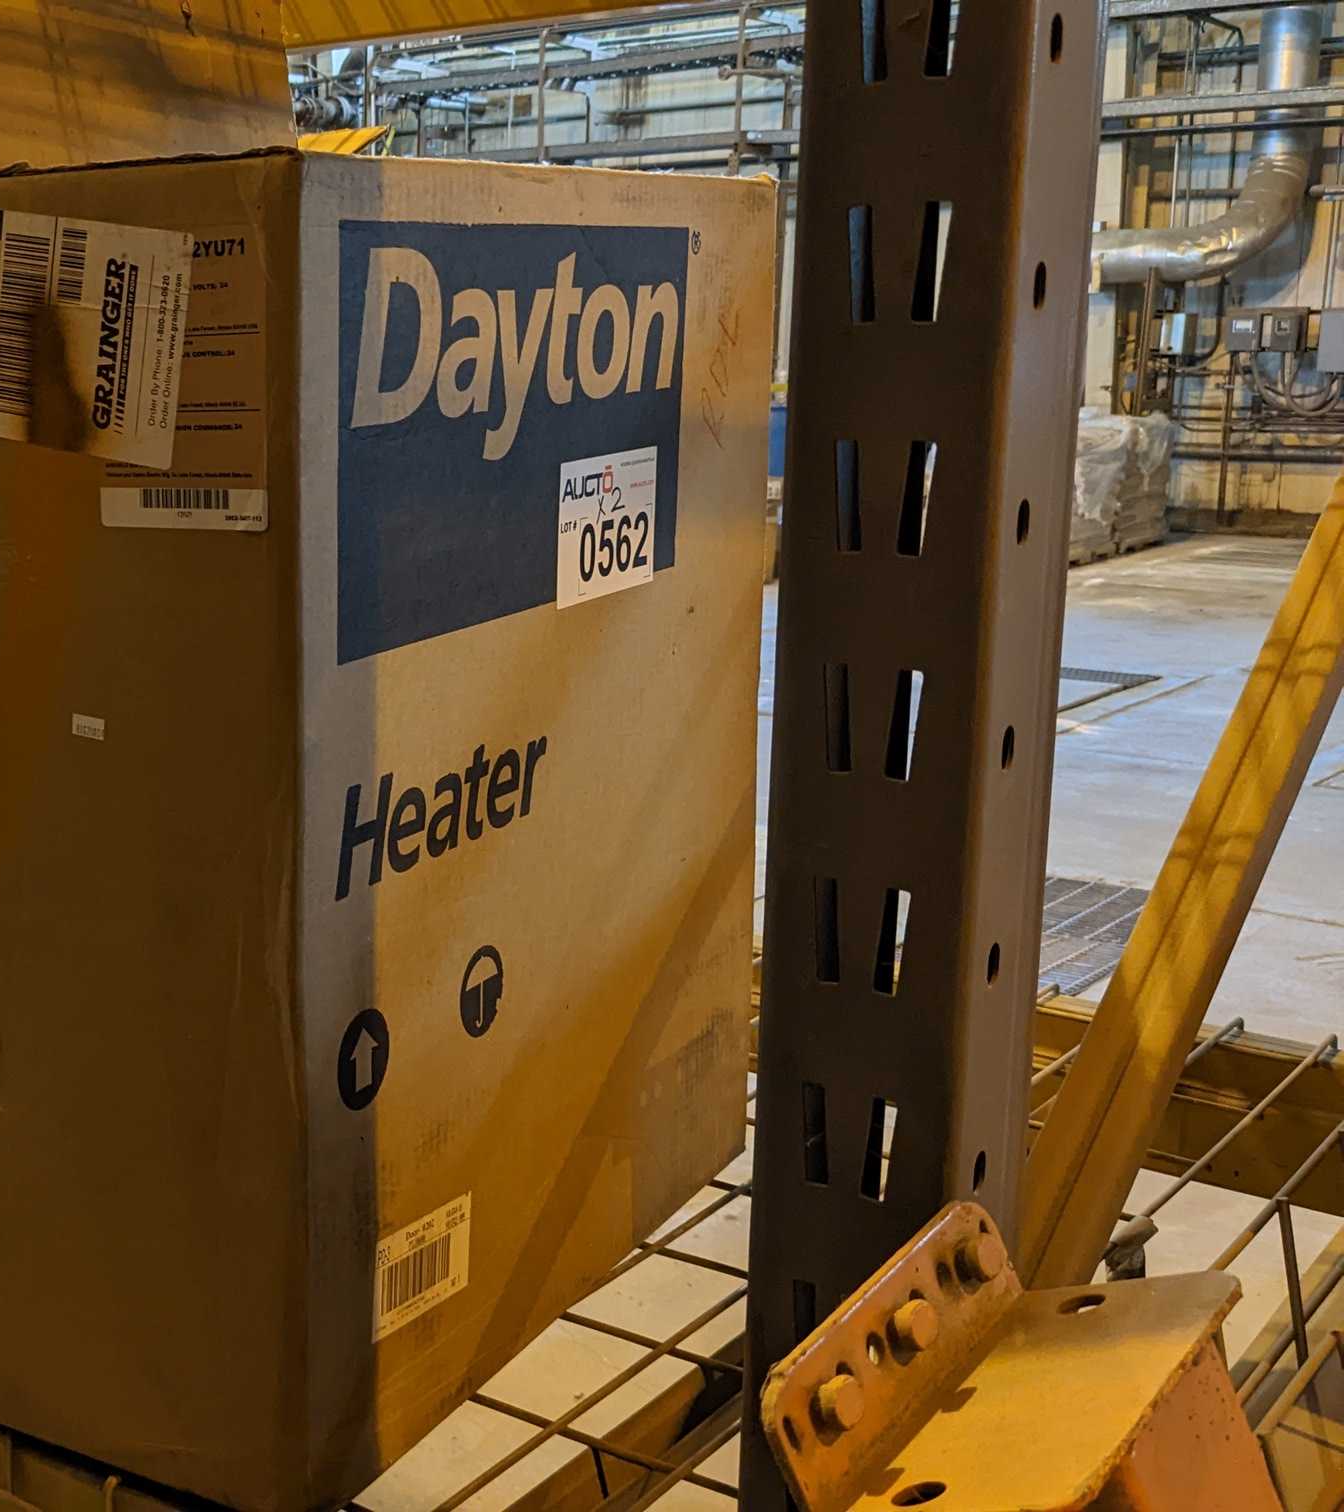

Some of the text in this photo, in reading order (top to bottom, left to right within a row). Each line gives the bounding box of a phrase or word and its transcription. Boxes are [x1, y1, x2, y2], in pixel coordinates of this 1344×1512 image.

[192, 238, 245, 258] 2YU71
[91, 257, 127, 431] GRAINGER
[351, 247, 679, 461] Dayton
[150, 382, 160, 395] By
[147, 399, 158, 426] Order
[159, 400, 170, 429] Order
[560, 521, 572, 534] LOT
[579, 511, 649, 583] 0562
[336, 735, 547, 901] Heater
